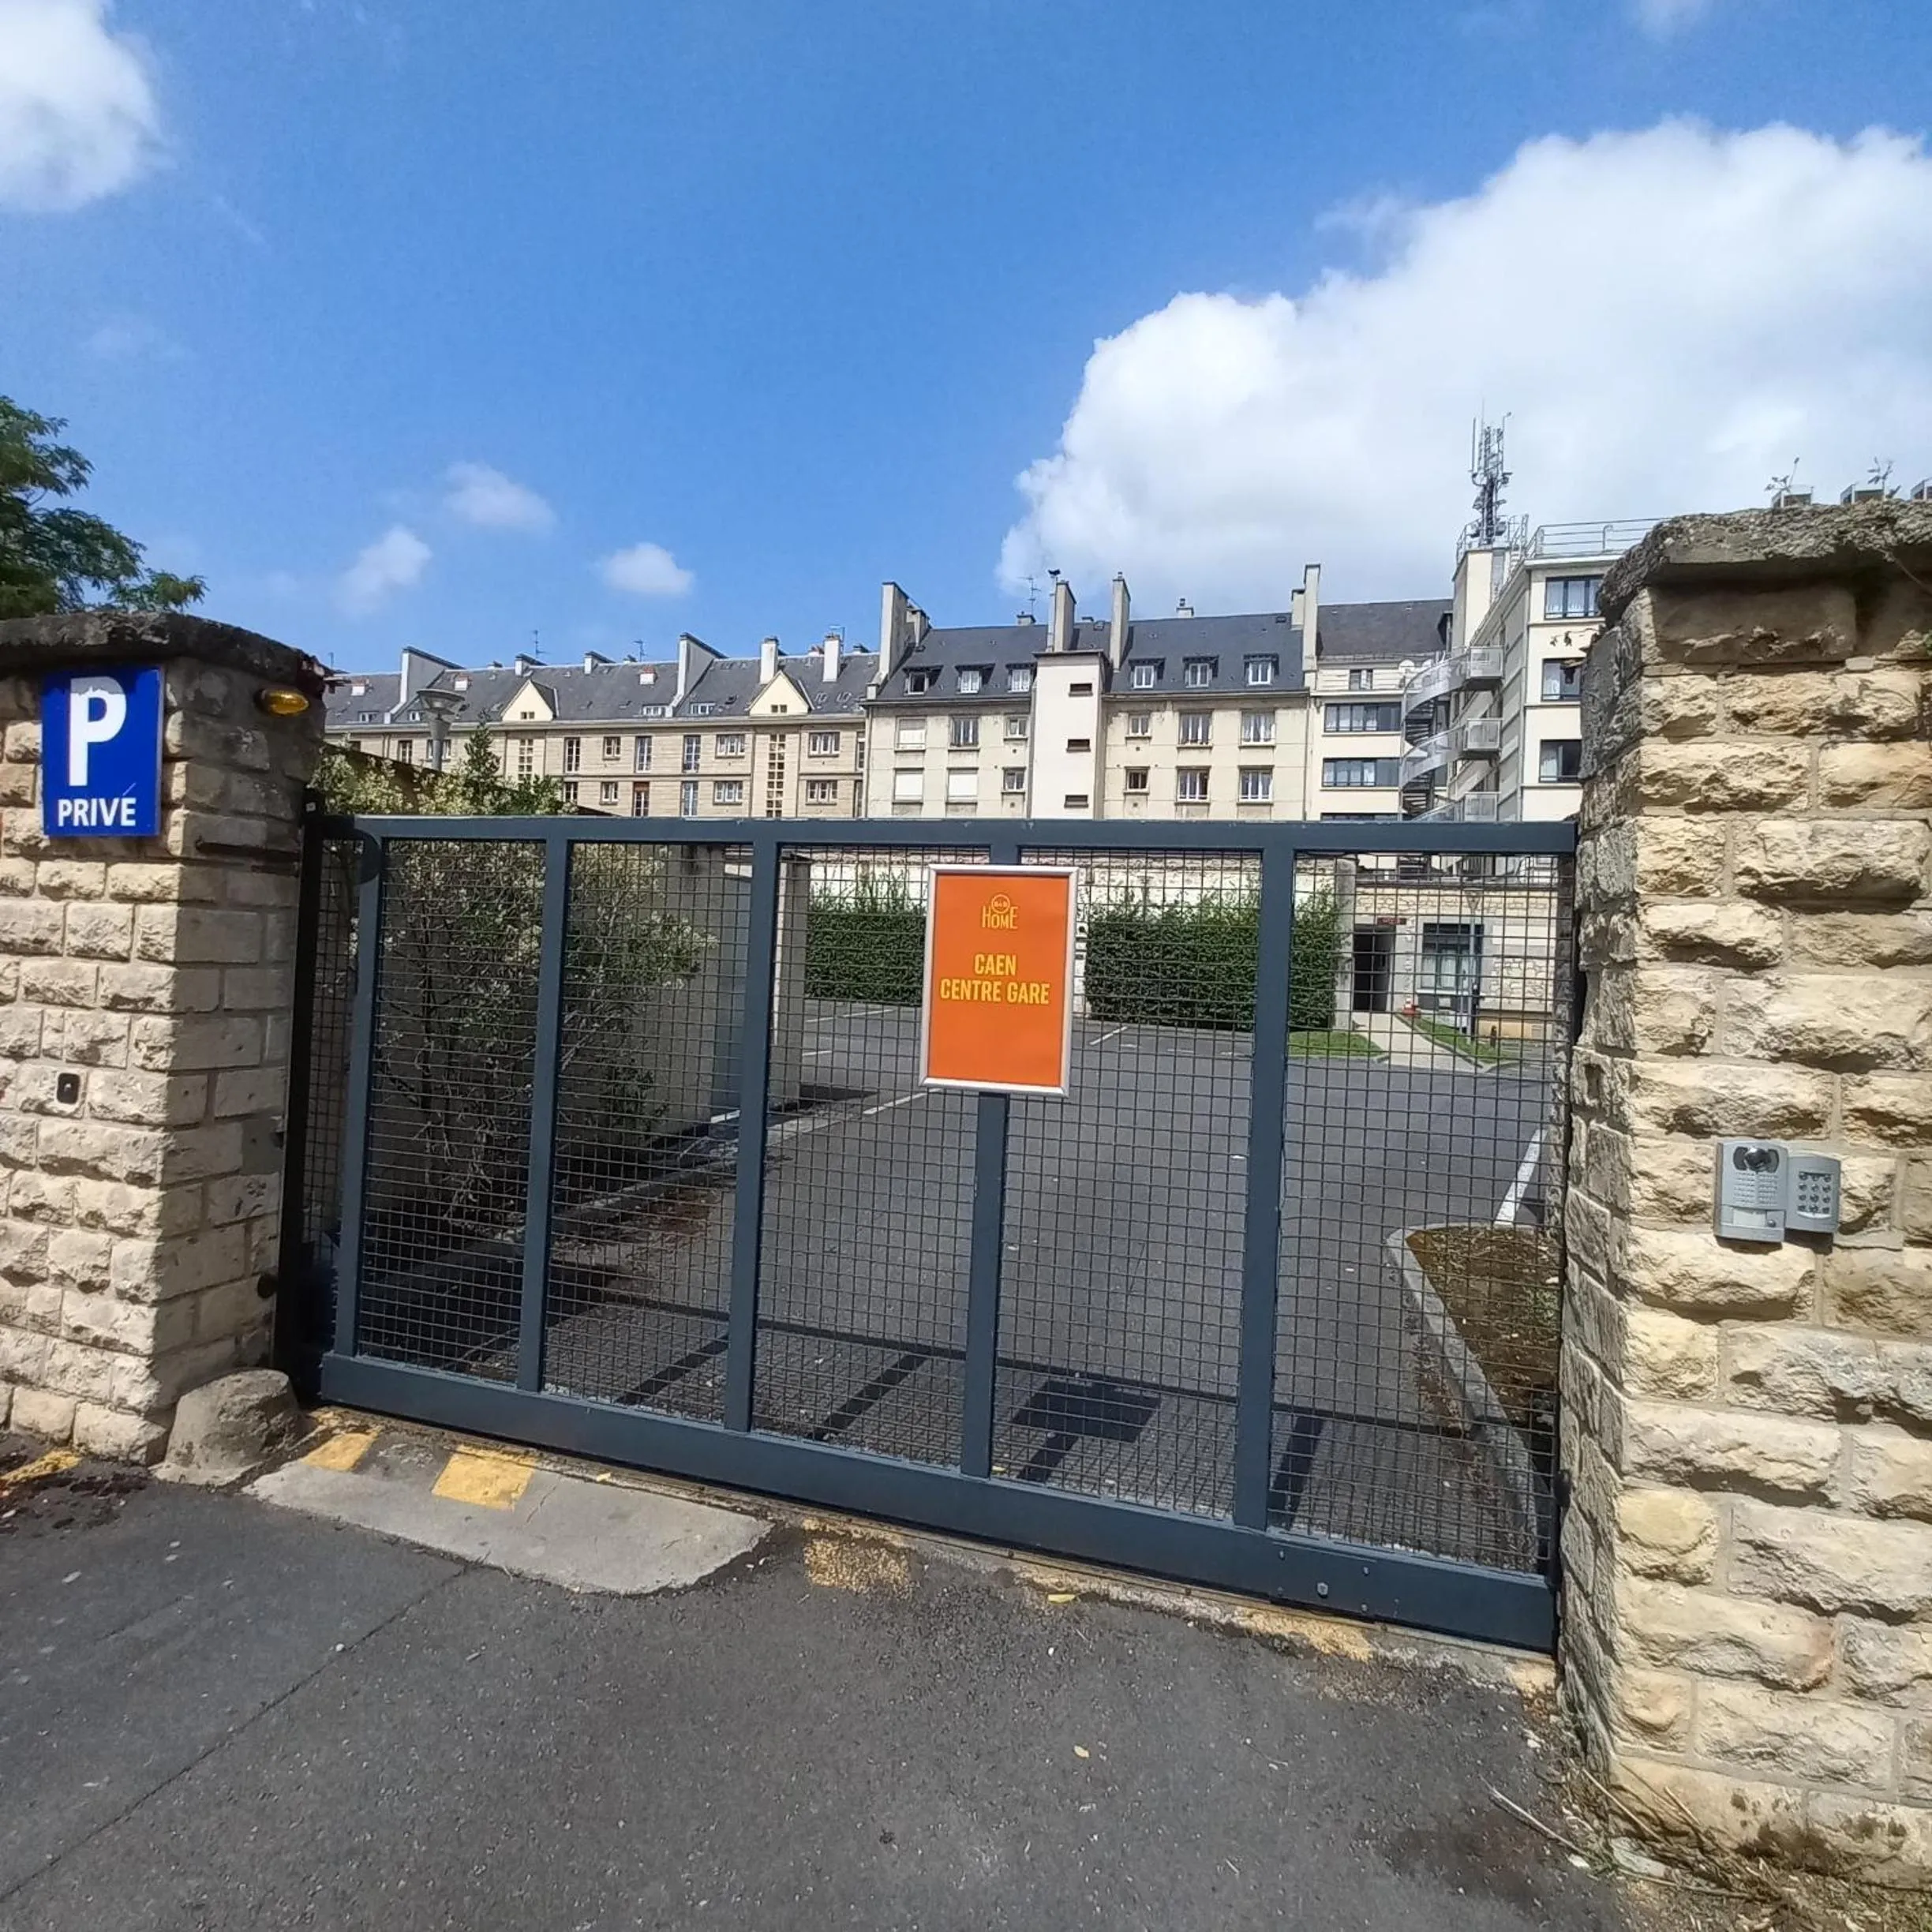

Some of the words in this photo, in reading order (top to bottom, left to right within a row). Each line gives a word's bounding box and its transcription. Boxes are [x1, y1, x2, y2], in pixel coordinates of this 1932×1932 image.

[69, 676, 126, 786] P
[58, 783, 137, 826] PRIVÉ
[982, 905, 1018, 929] HOME
[974, 953, 1017, 975] CAEN
[940, 979, 1002, 1002] CENTRE
[1007, 982, 1050, 1005] GARE
